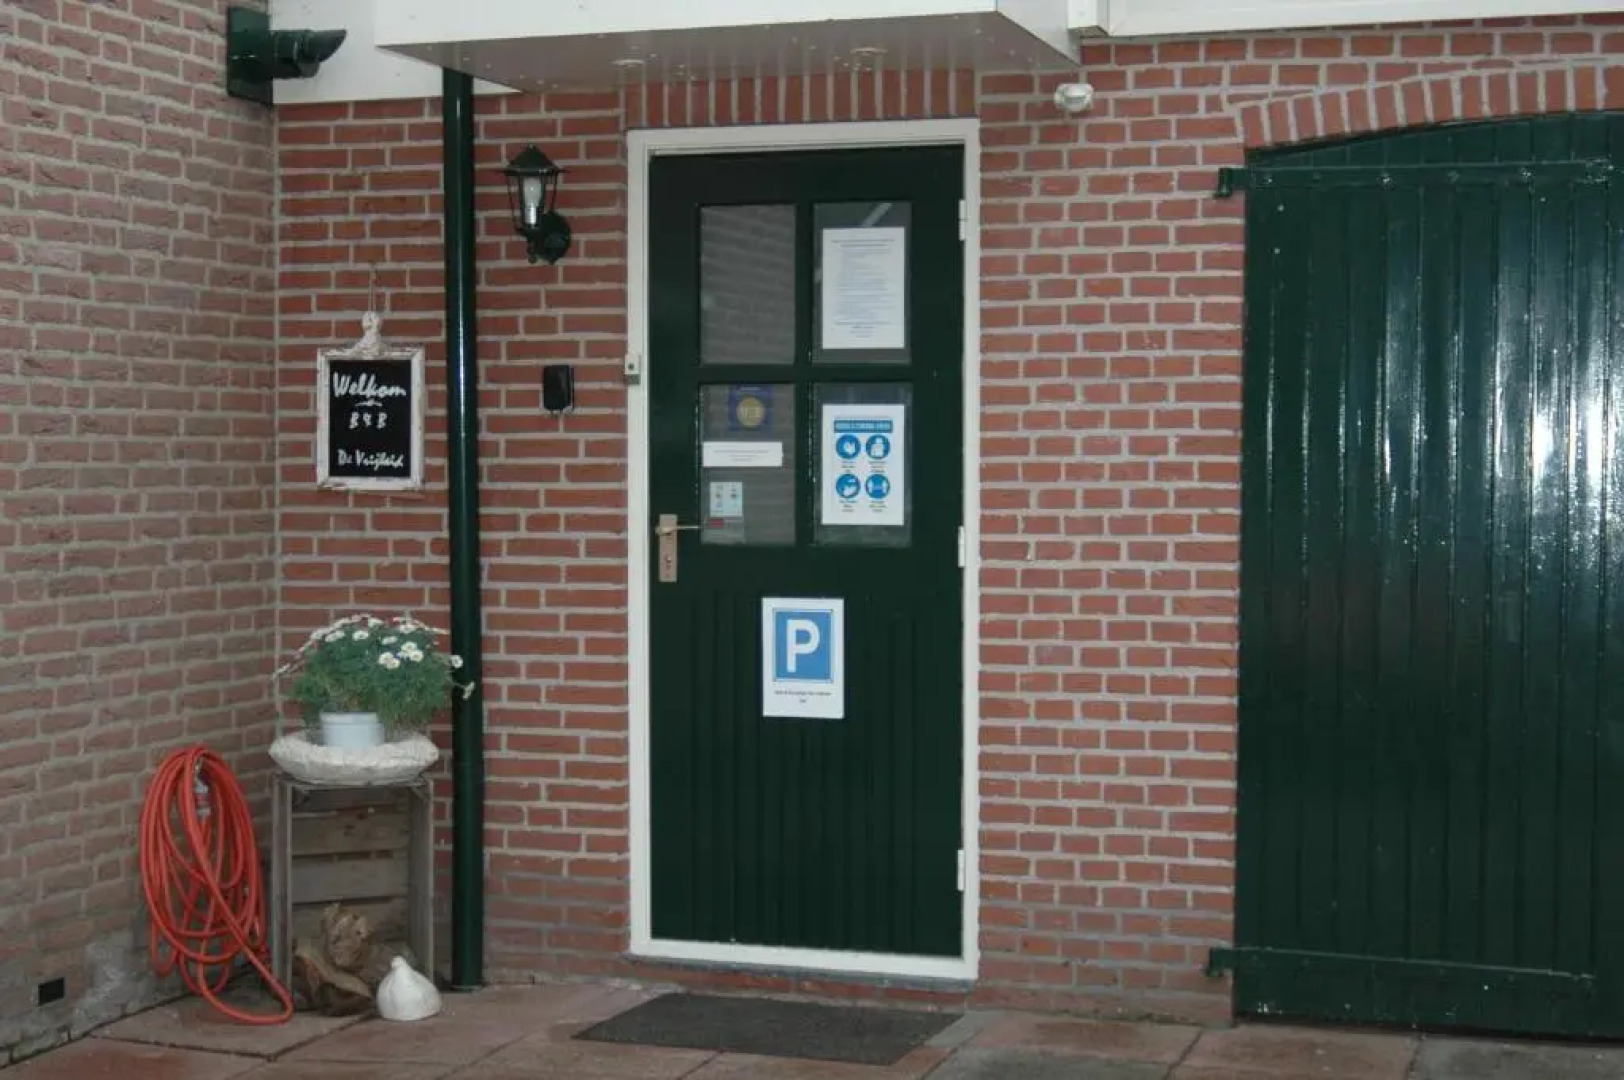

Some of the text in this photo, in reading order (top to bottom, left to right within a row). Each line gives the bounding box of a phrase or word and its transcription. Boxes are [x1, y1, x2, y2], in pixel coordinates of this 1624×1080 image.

[333, 371, 407, 398] Welkom
[349, 411, 361, 429] B
[376, 411, 388, 429] B
[786, 619, 821, 673] P
